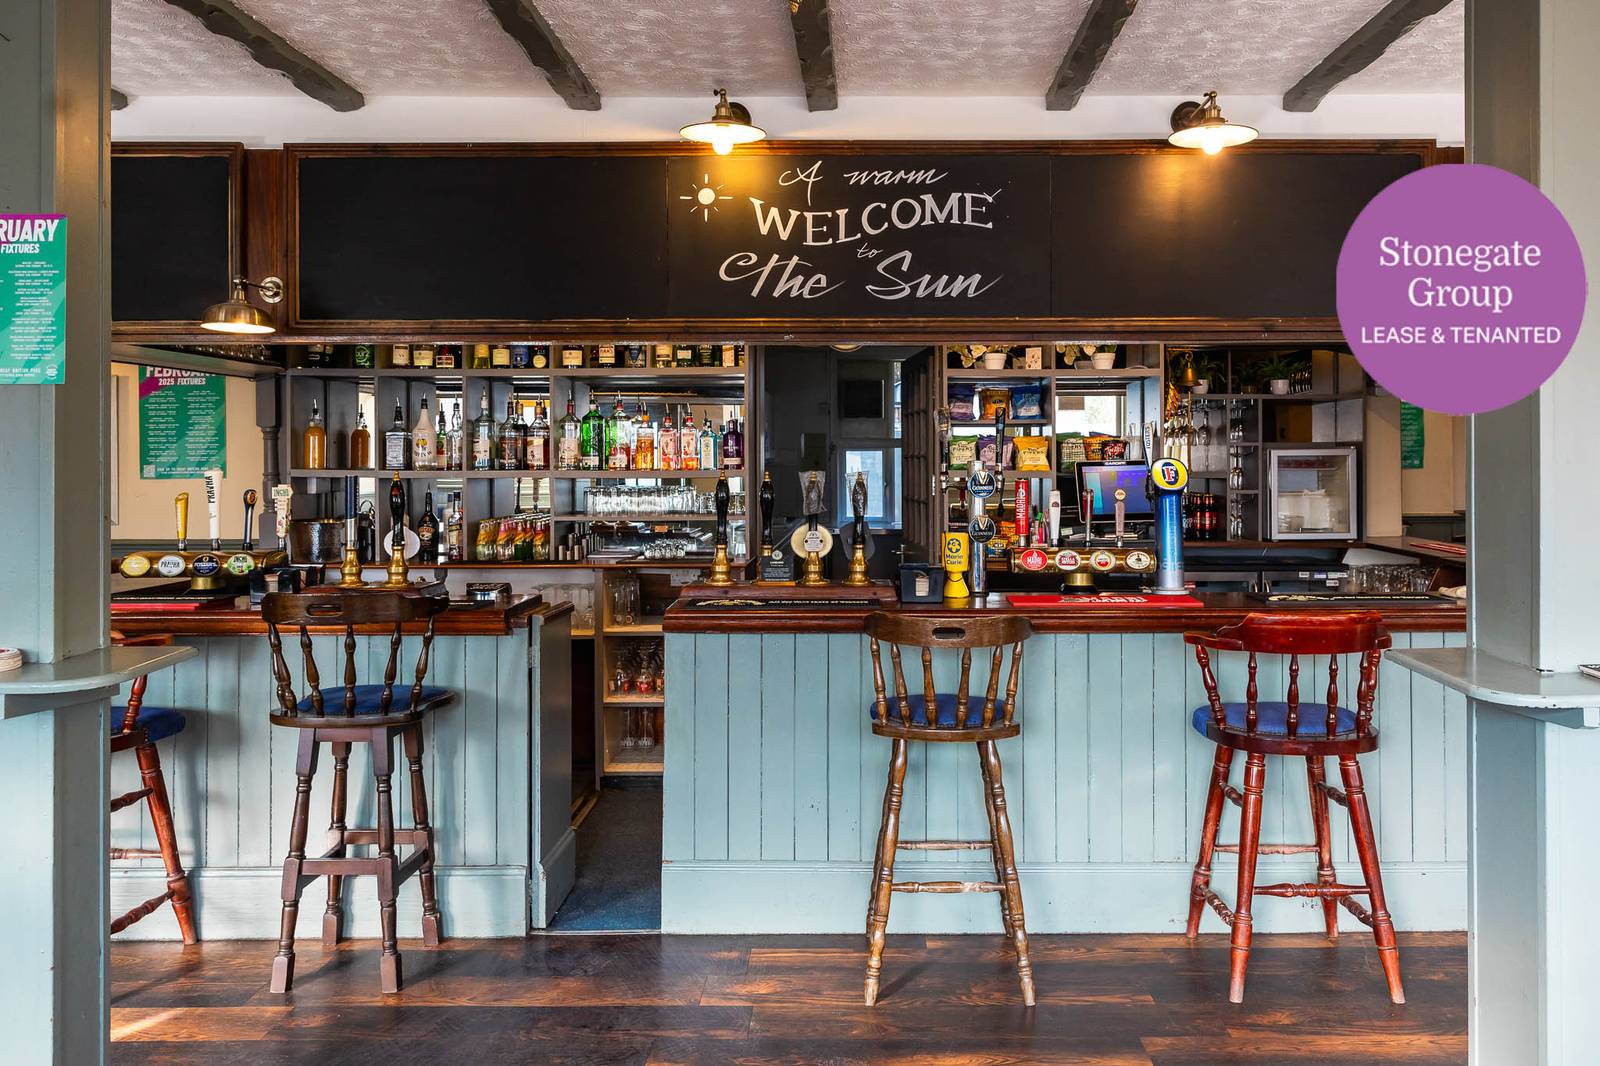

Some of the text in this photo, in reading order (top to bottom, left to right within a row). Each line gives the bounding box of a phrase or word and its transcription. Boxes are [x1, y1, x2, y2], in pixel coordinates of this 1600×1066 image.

[779, 160, 948, 206] A warm
[749, 189, 1001, 246] WELCOME
[1, 244, 40, 254] FIXTURES
[857, 242, 884, 258] to
[719, 250, 1004, 300] The Sun
[158, 377, 206, 386] 2025 FIXTURES
